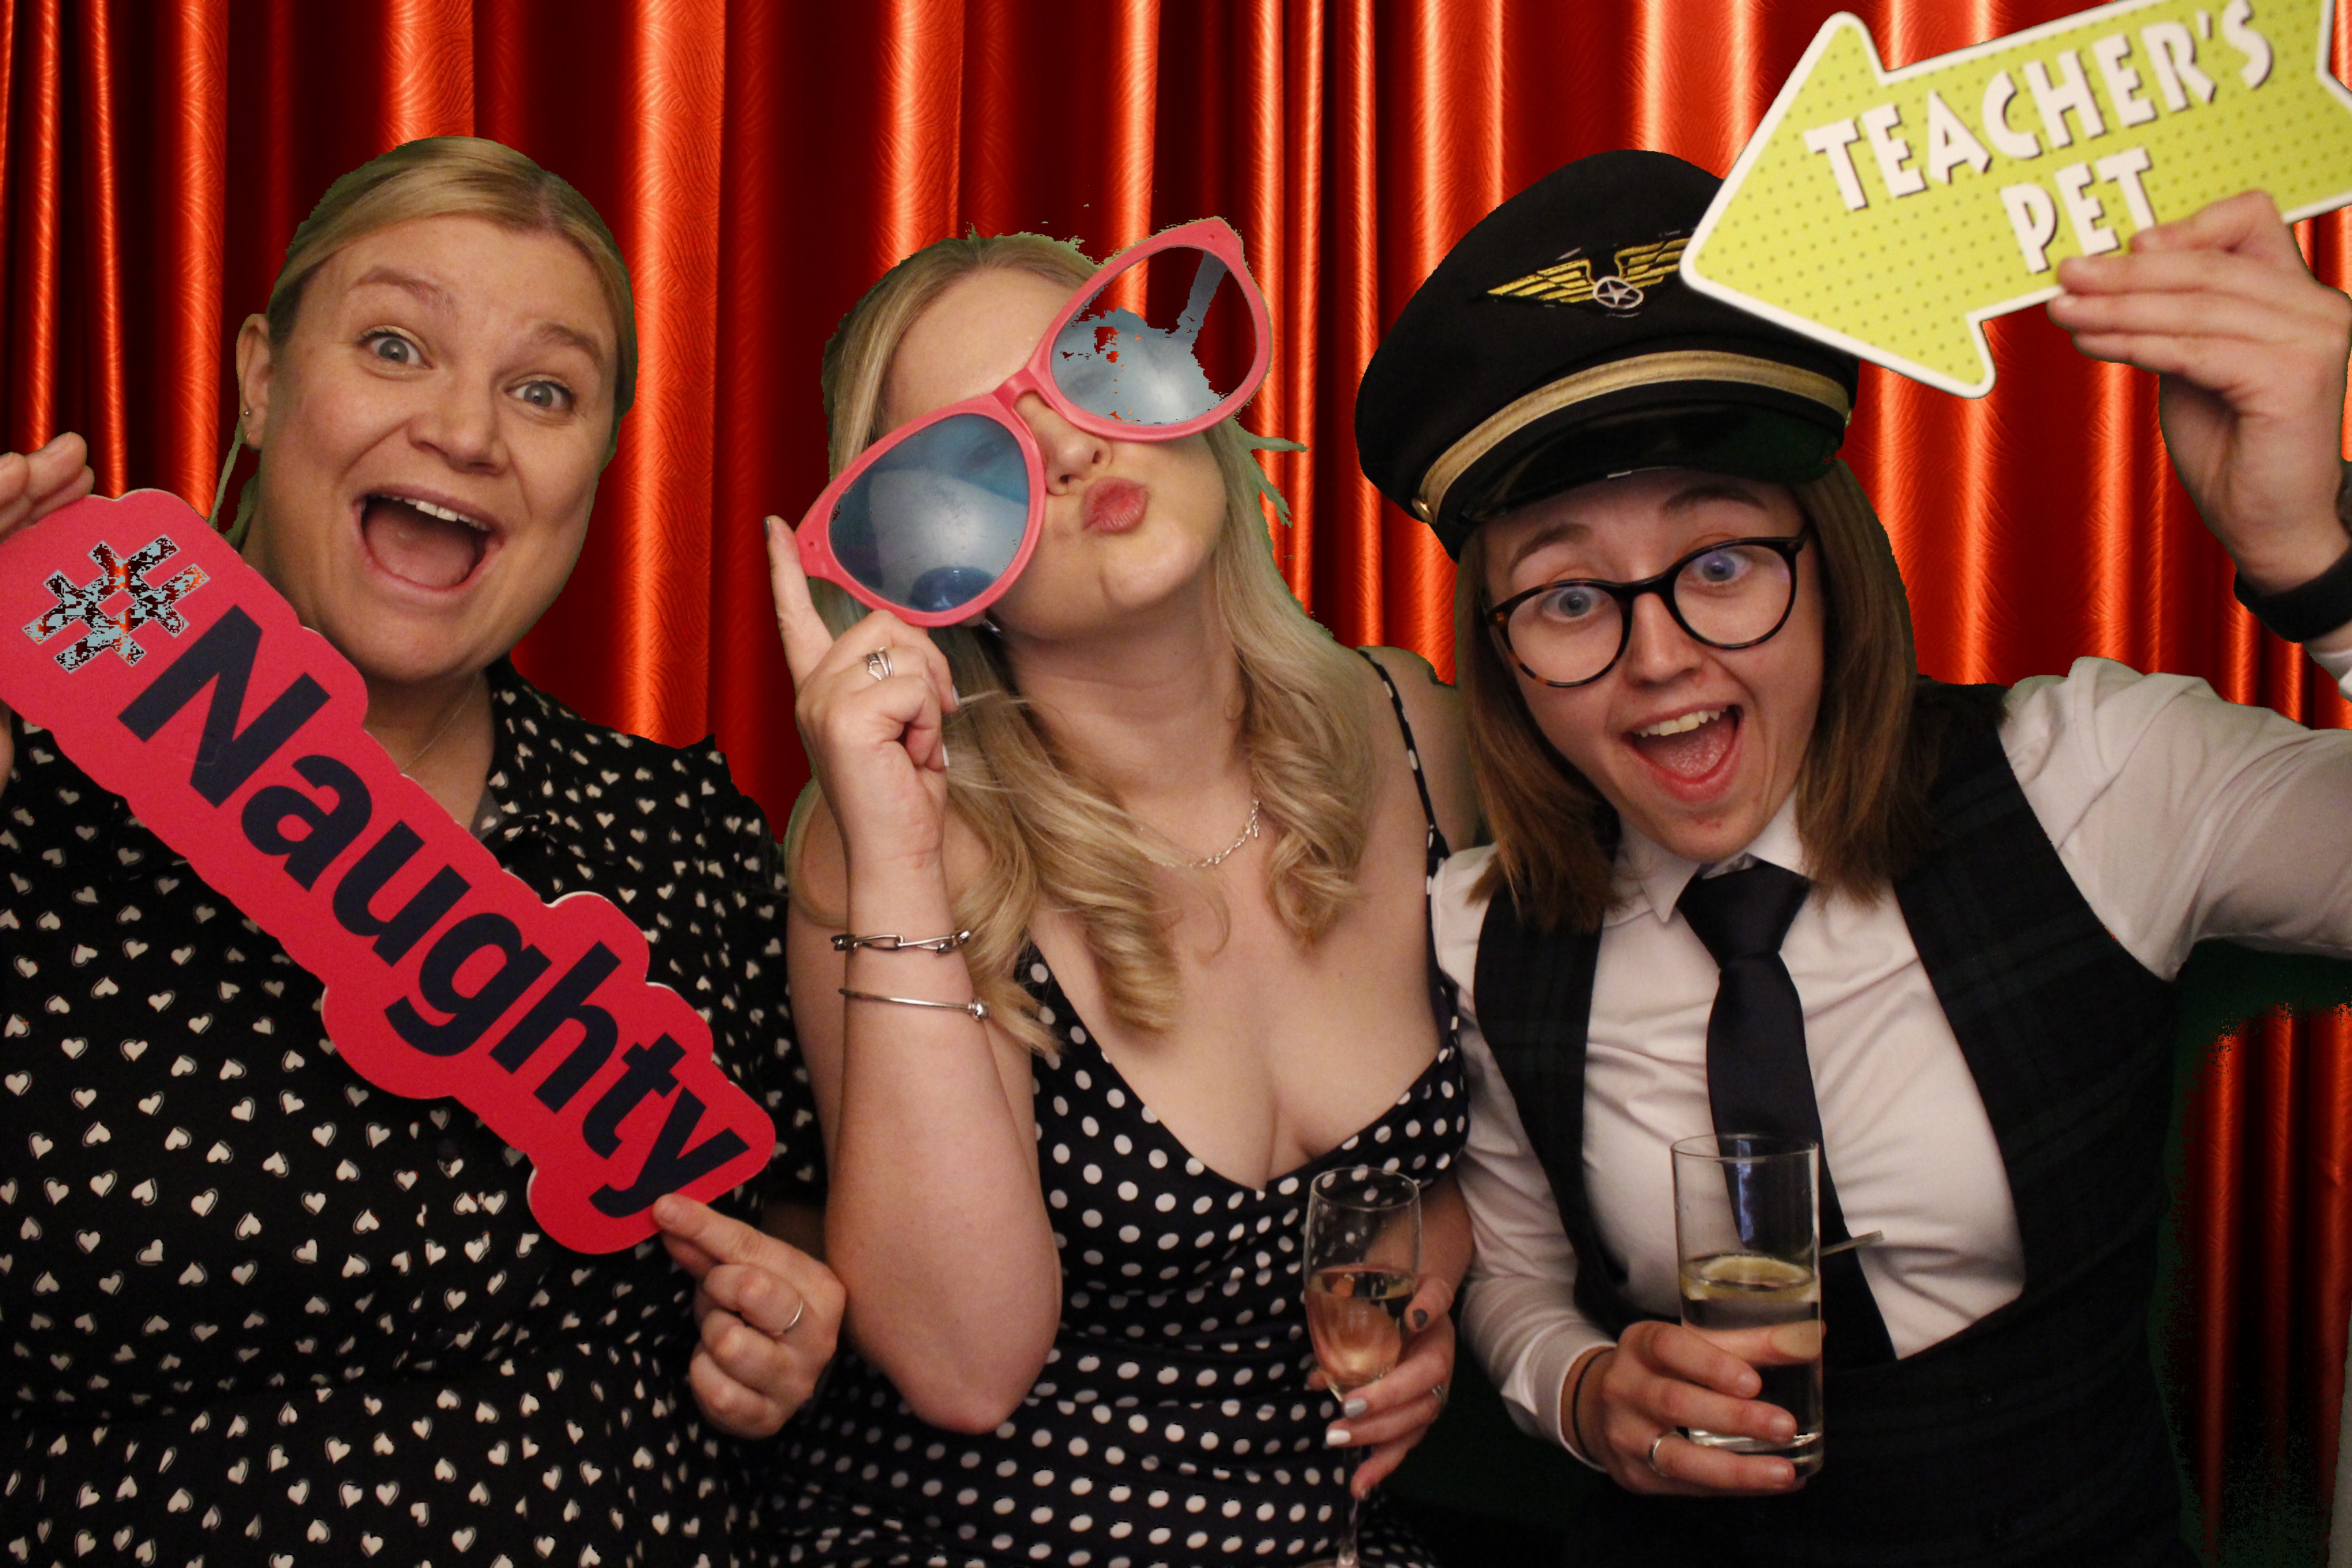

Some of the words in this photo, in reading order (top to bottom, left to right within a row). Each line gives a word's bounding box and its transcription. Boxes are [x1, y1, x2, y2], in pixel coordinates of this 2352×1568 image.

[1803, 0, 2274, 211] TEACHER'S
[1999, 147, 2157, 274] PET
[22, 534, 751, 1218] #Naughty
